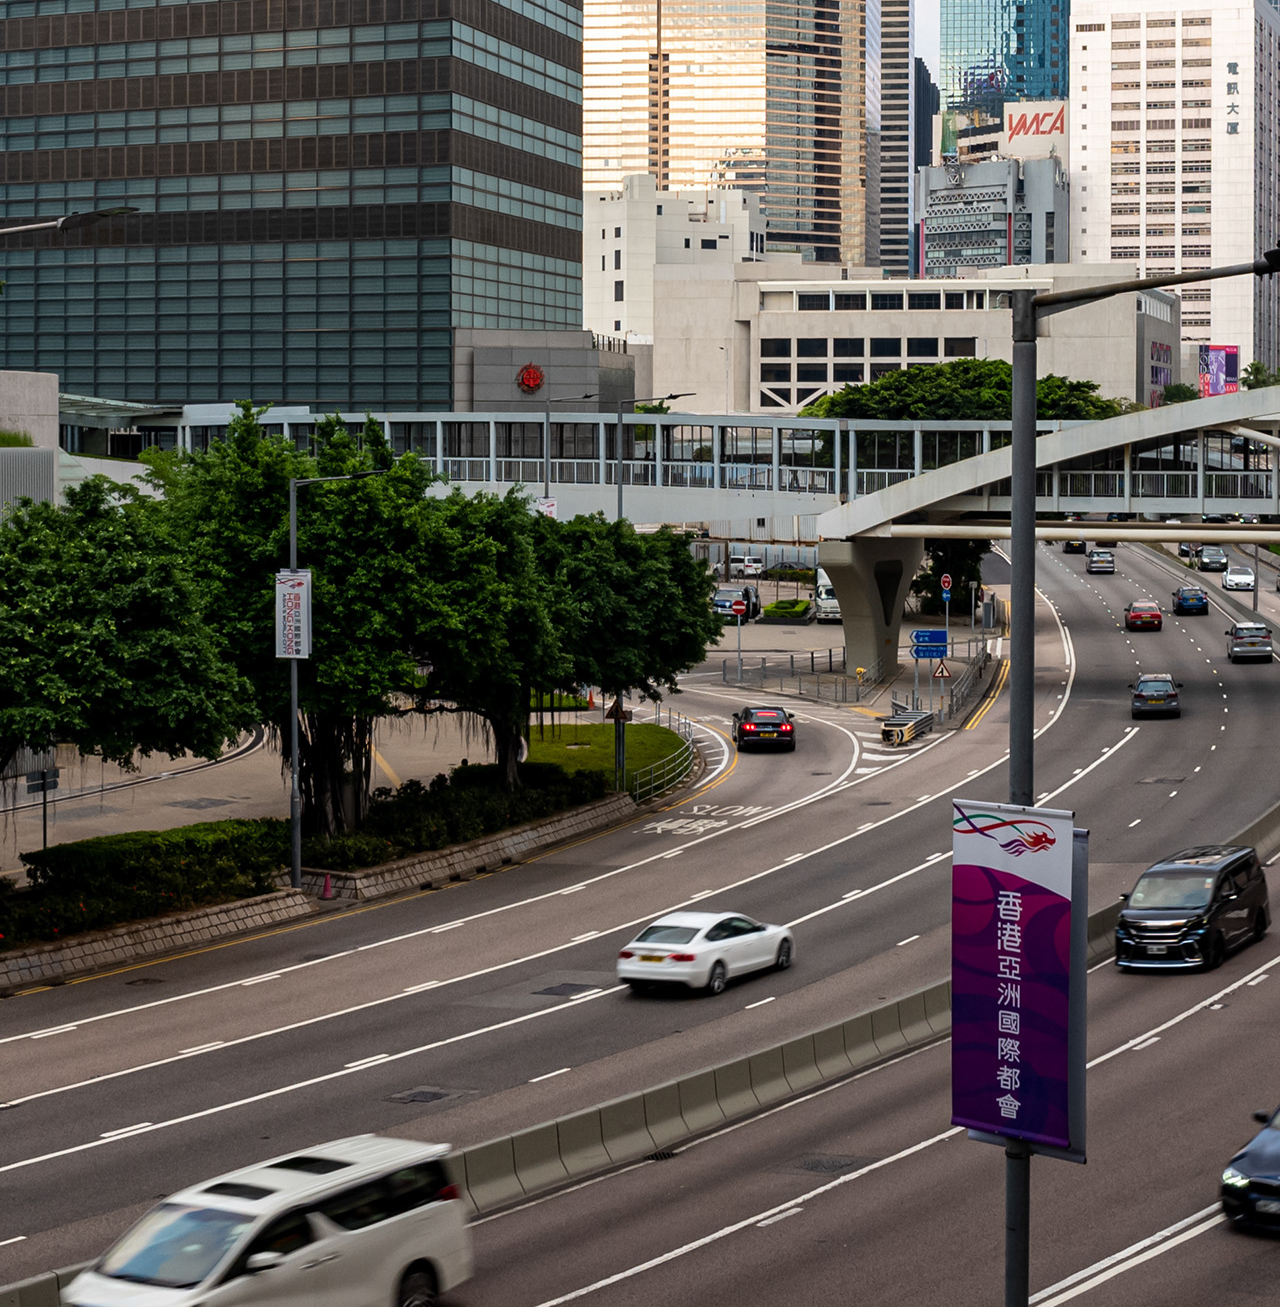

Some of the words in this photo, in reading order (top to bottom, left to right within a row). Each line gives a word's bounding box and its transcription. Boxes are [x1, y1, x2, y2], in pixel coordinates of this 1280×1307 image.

[1226, 62, 1240, 135] 電訊大廈
[1008, 104, 1065, 144] YMCA
[1199, 355, 1225, 365] OPEN
[1200, 365, 1217, 374] DAY
[1199, 374, 1217, 383] 2021
[996, 890, 1022, 1120] 香港亞洲國際都會
